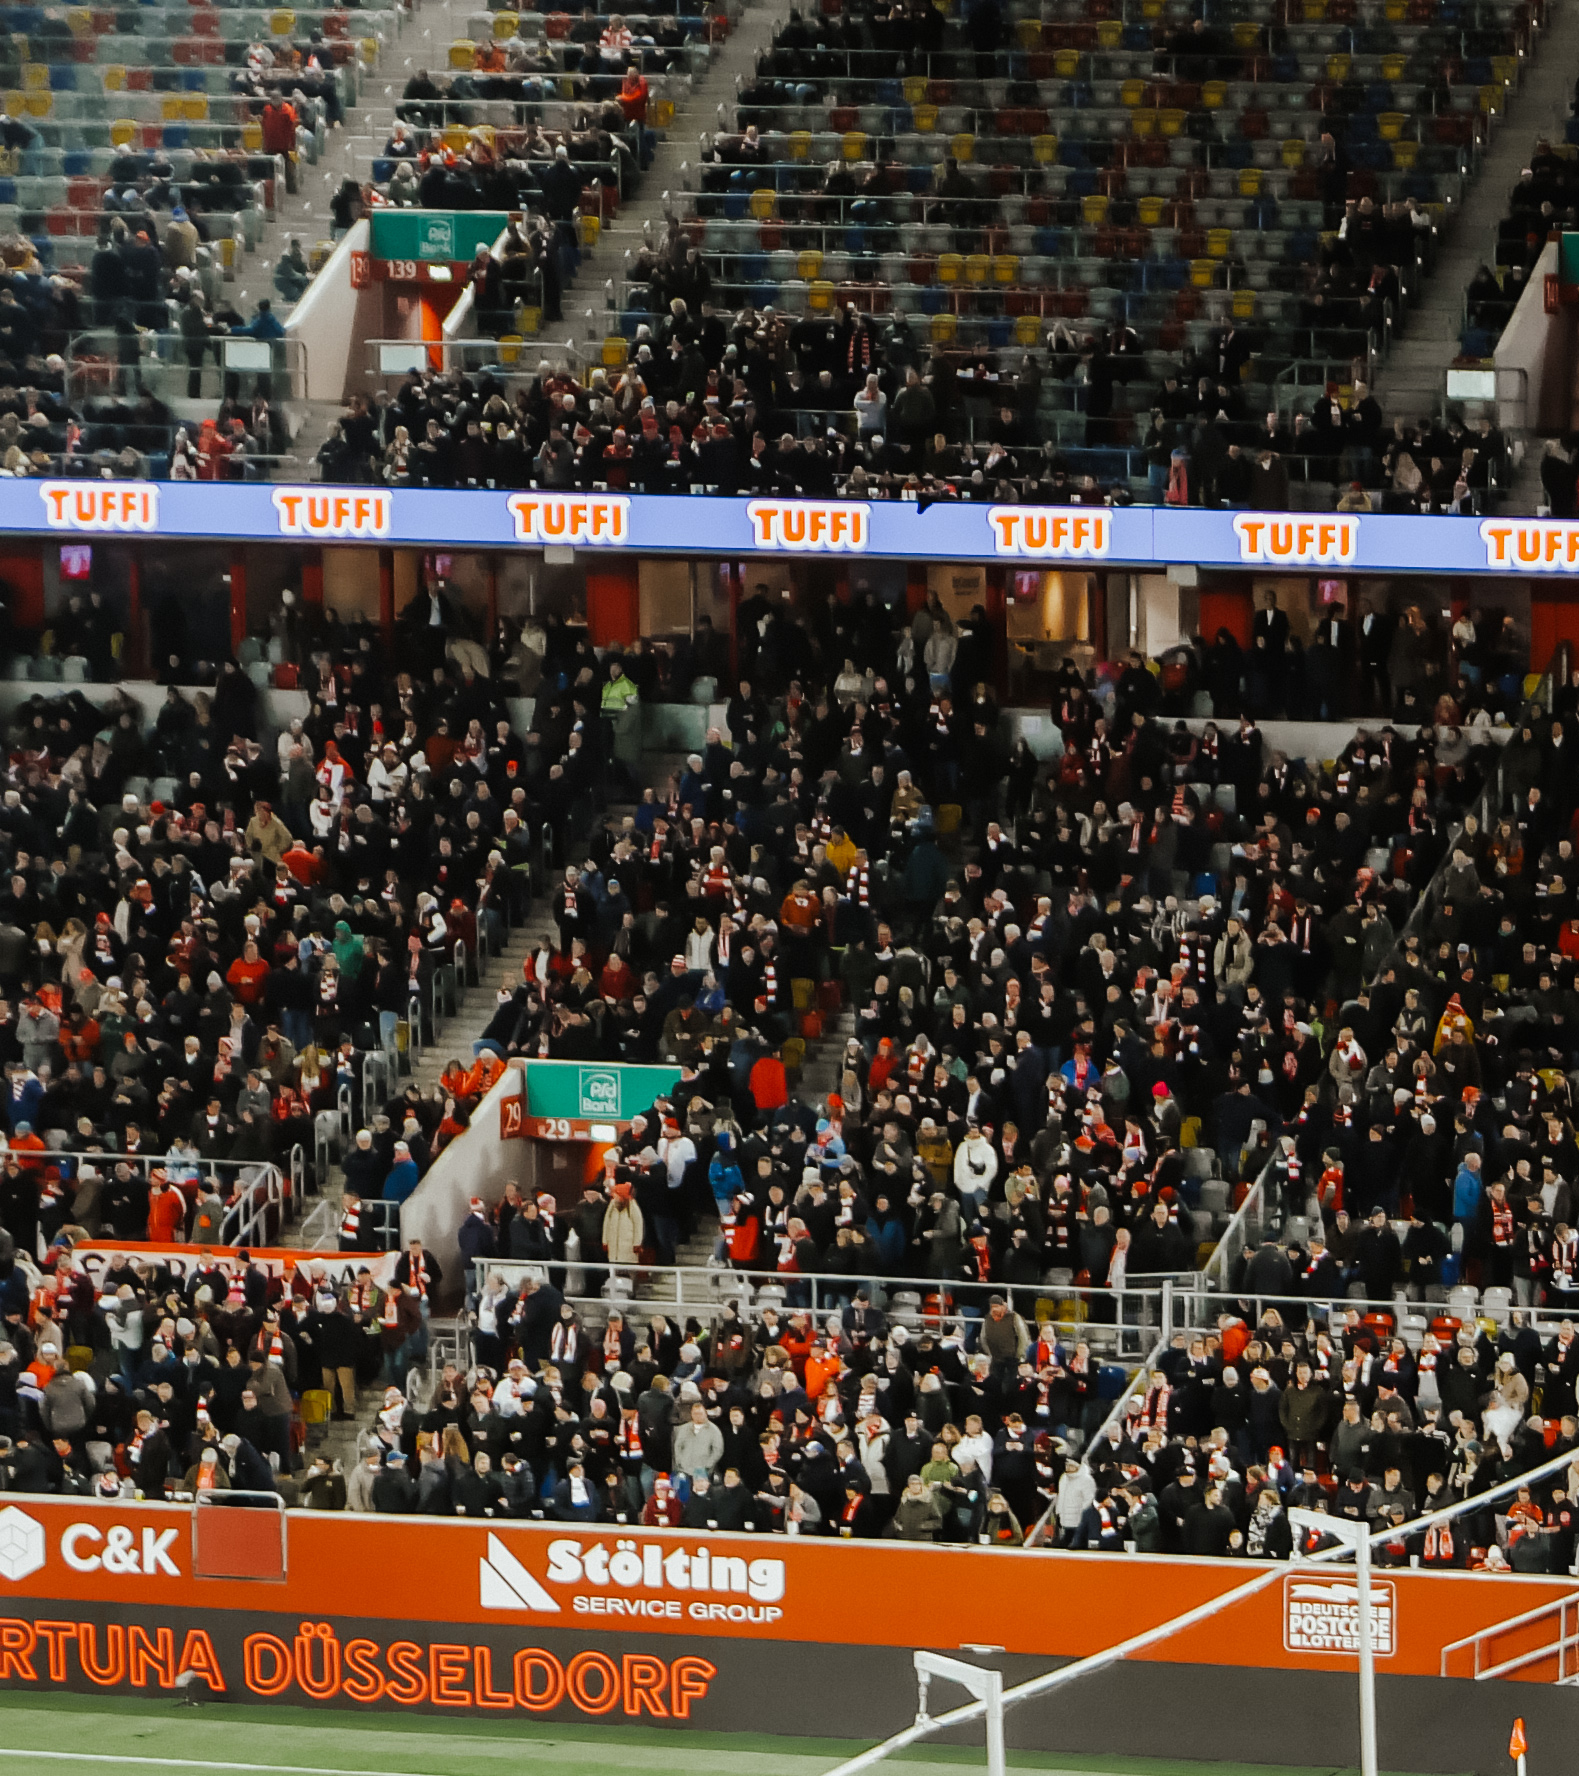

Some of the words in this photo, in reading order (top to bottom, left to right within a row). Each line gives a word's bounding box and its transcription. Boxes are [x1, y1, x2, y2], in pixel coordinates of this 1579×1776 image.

[387, 260, 417, 279] 139
[48, 490, 149, 524] TUFFI
[279, 496, 386, 532] TUFFI
[515, 501, 623, 538] TUFFI
[753, 508, 863, 544] TUFFI
[995, 514, 1105, 550] TUFFI
[1241, 521, 1350, 556] TUFFI
[505, 1101, 521, 1132] 29
[583, 1096, 618, 1113] Bank
[545, 1118, 570, 1140] 29
[60, 1523, 182, 1578] C&K
[546, 1538, 786, 1602] Stölting
[572, 1595, 686, 1621] SERVICE
[689, 1602, 784, 1626] GROUP
[1301, 1602, 1380, 1622] DEUTSCE
[1301, 1634, 1380, 1652] LOTTERE
[242, 1621, 719, 1721] DÜSSELDORF
